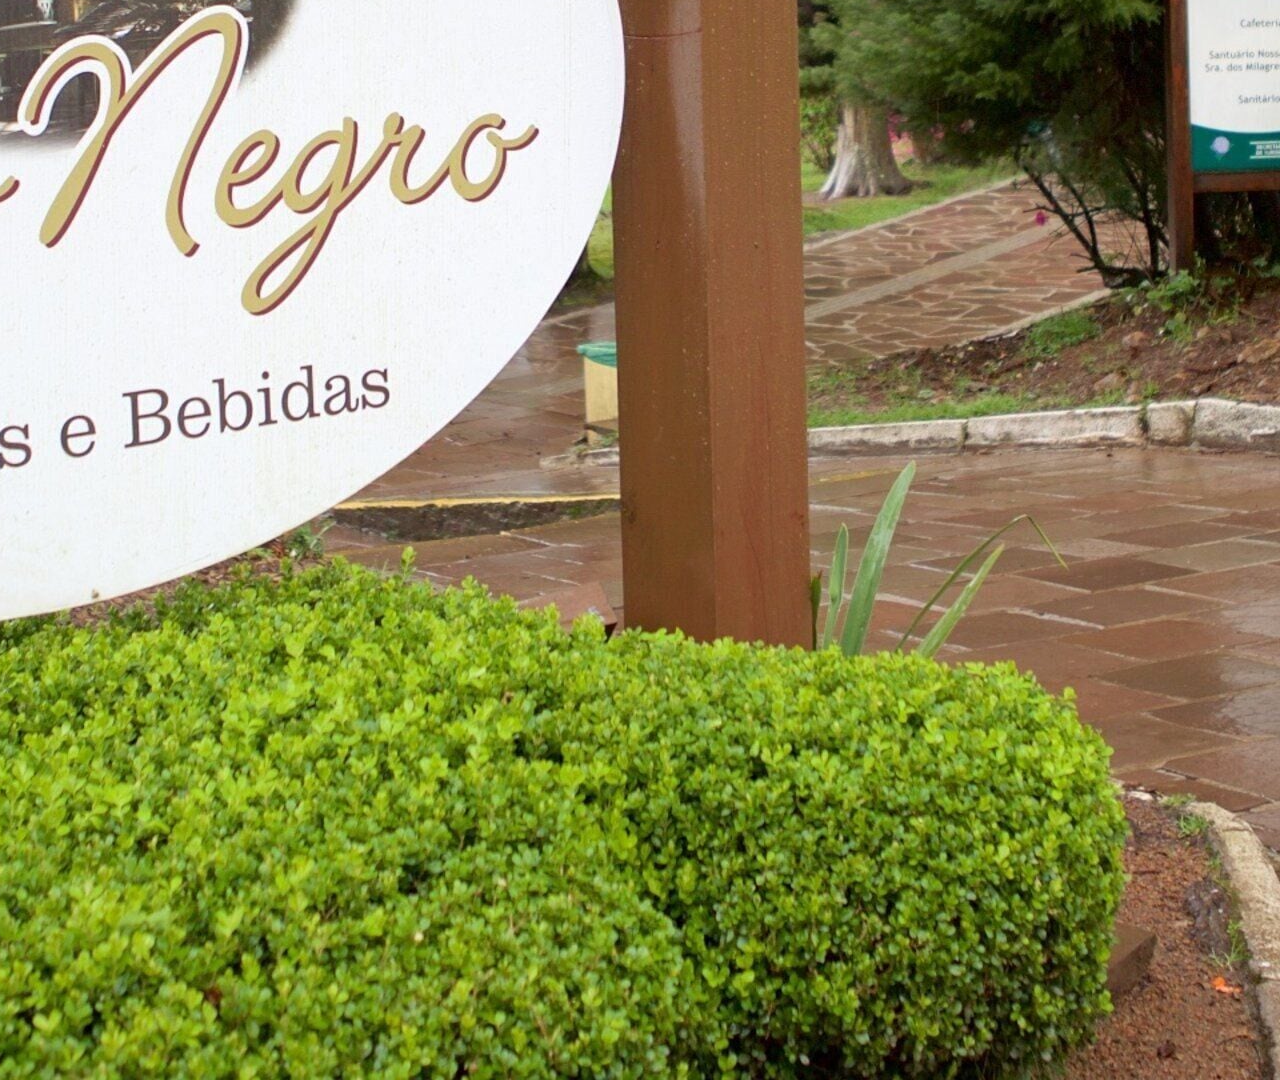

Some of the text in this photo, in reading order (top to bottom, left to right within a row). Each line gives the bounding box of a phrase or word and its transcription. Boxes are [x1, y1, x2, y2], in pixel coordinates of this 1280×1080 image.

[1226, 63, 1243, 72] dos
[24, 12, 540, 317] Negro
[61, 415, 96, 458] e
[121, 365, 390, 449] Bebidas
